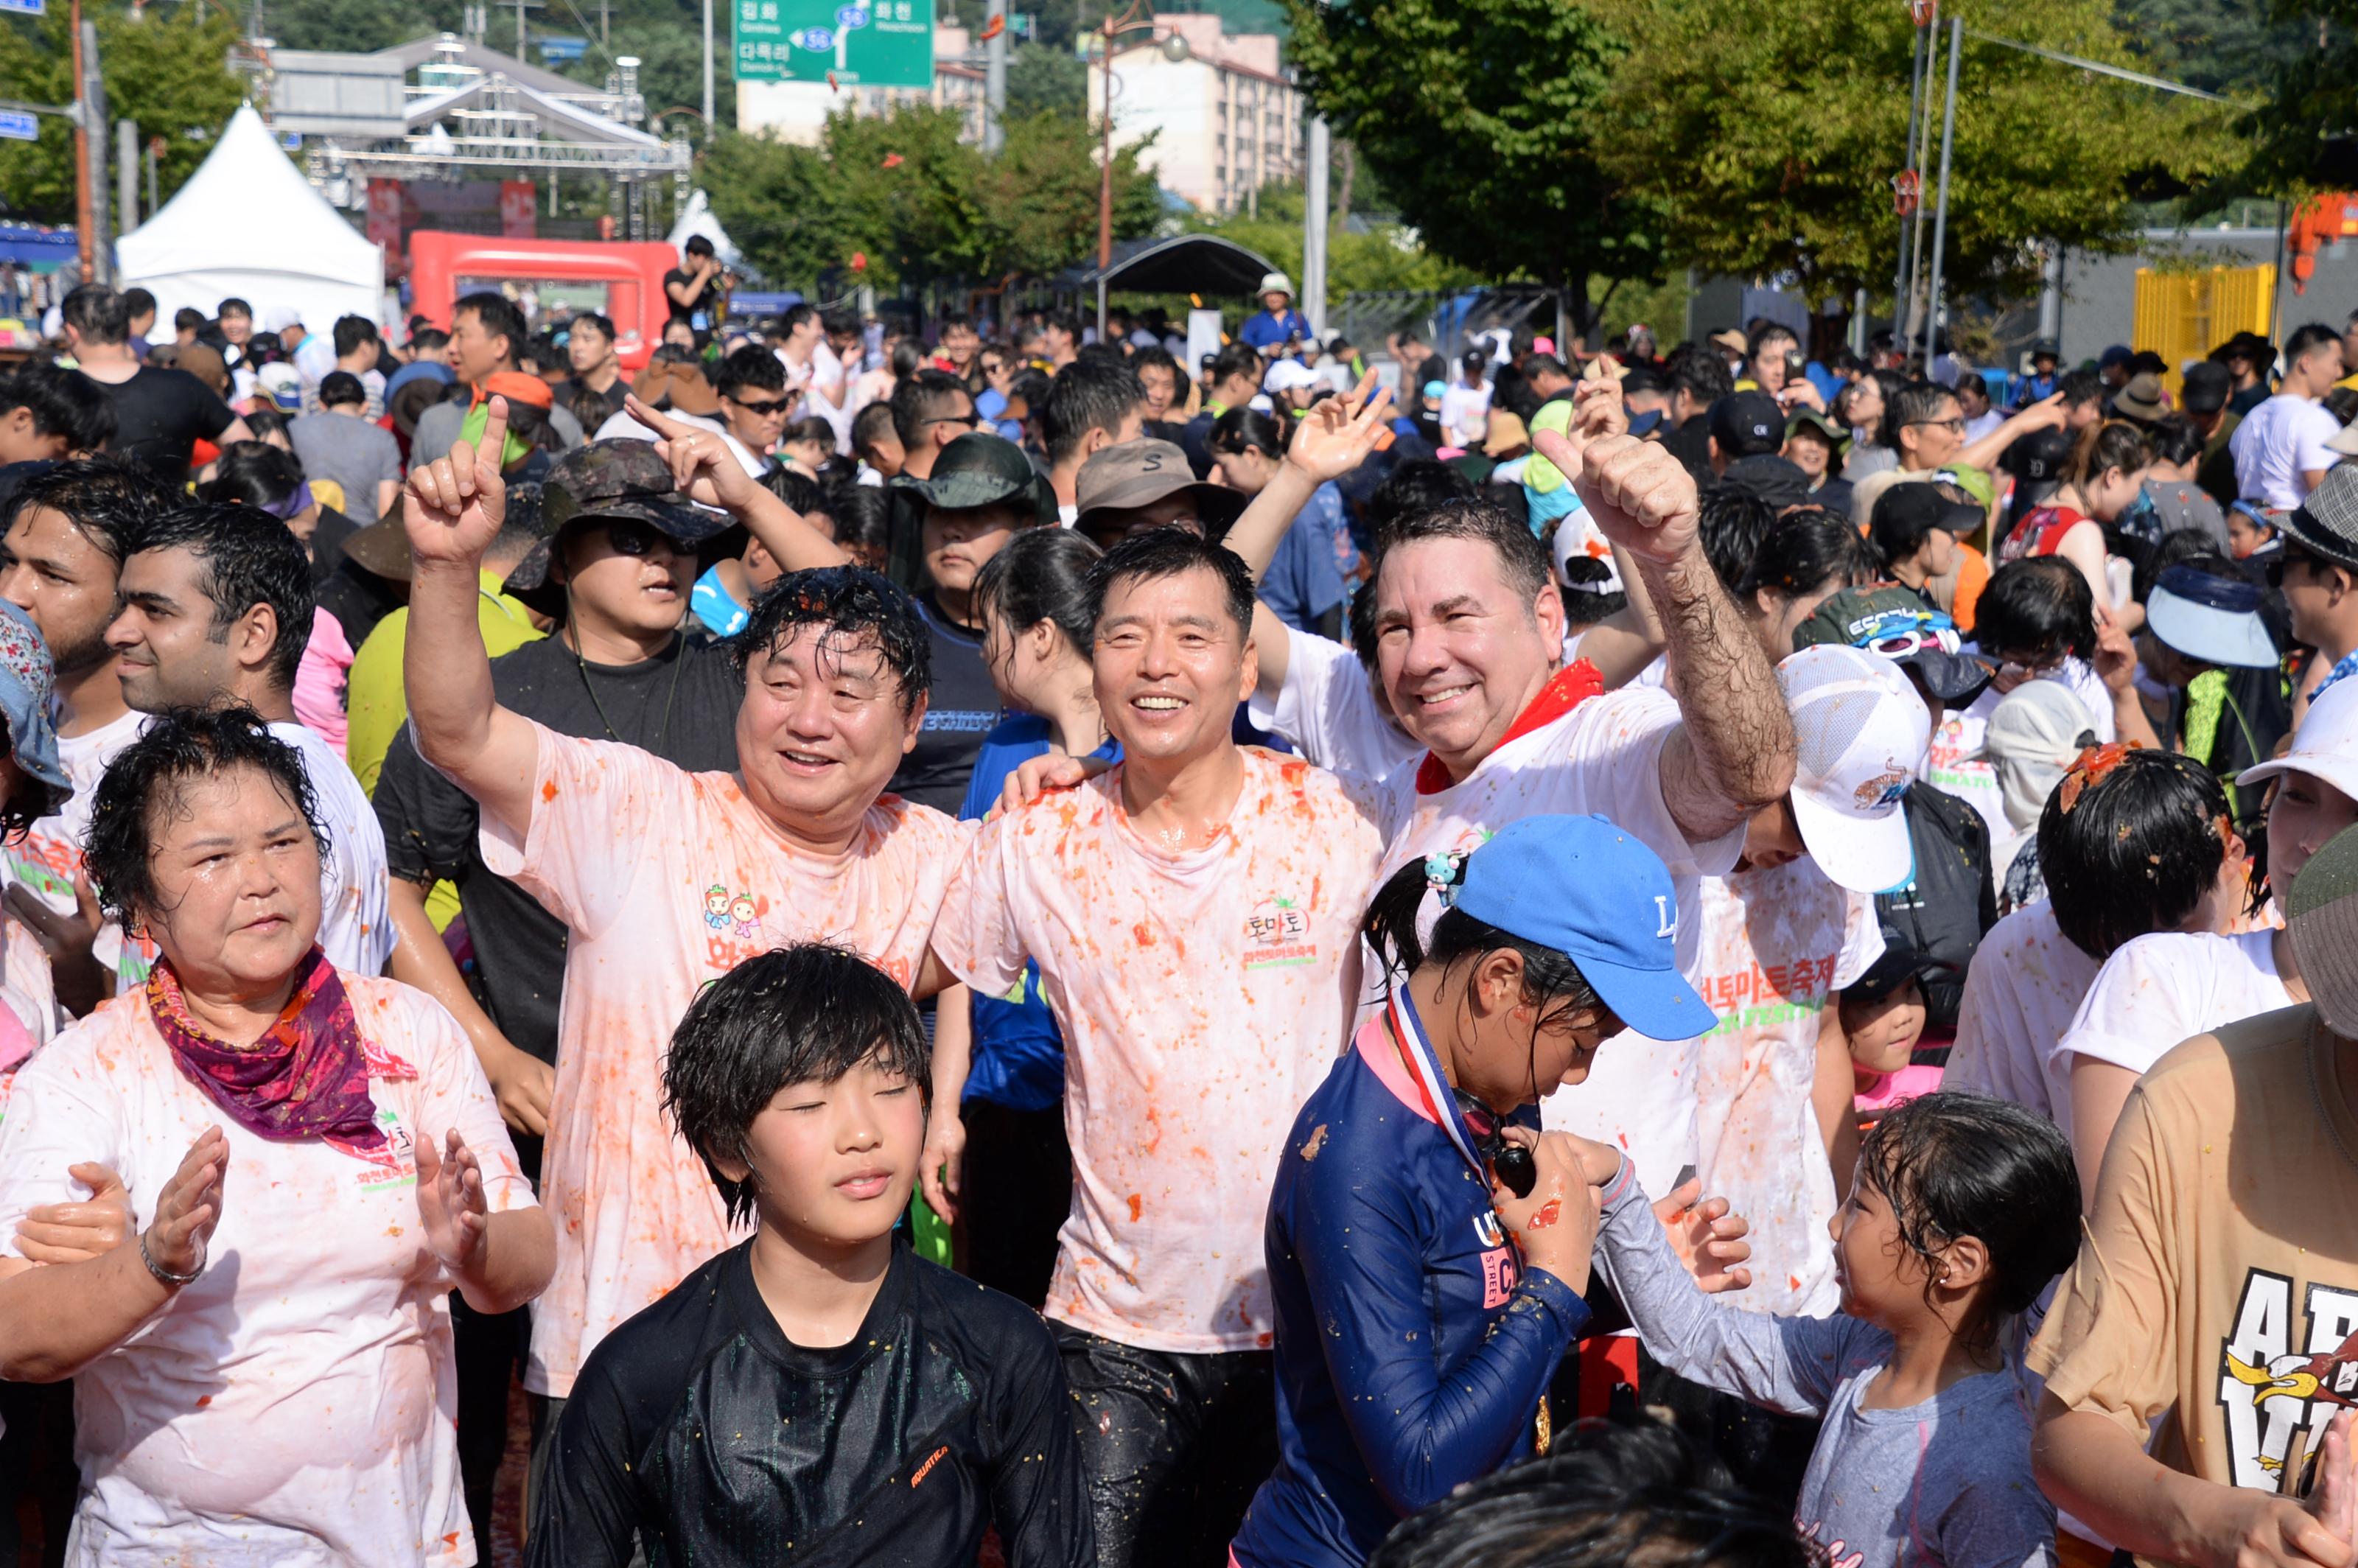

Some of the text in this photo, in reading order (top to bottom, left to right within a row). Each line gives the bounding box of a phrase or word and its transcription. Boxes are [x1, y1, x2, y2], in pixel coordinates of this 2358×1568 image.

[841, 8, 865, 27] 56
[875, 1, 912, 21] 화천
[808, 32, 831, 50] 56
[739, 41, 790, 62] 다목리
[1143, 452, 1161, 472] S
[1248, 912, 1302, 938] 토마토
[1486, 1255, 1497, 1303] STREET
[911, 1446, 948, 1488] AQUATICA
